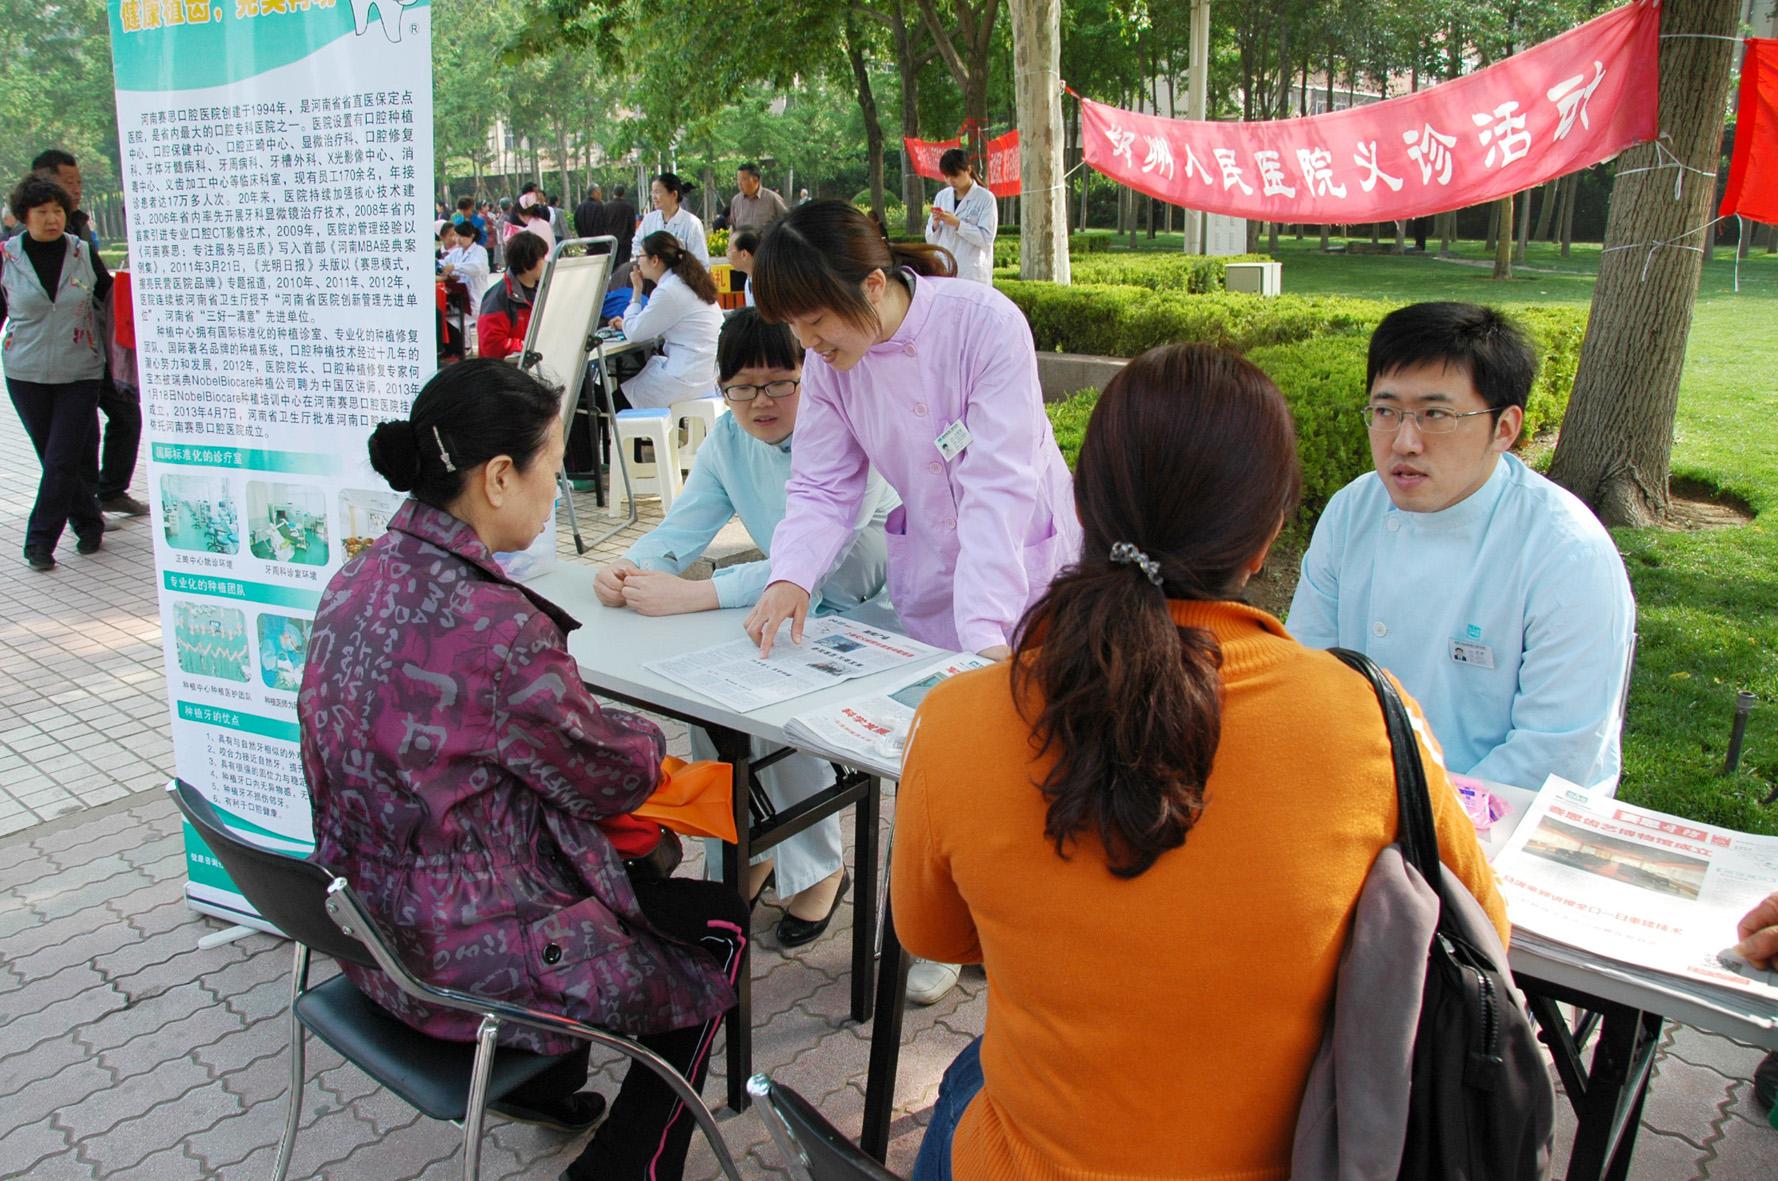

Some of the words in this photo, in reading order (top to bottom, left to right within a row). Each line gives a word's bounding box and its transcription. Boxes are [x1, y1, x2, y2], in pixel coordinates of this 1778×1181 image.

[148, 390, 411, 414] 1月18日NobelBiocare种植培训中心在河南赛思口腔医院挂
[170, 576, 246, 597] 专业化的种植团队
[184, 704, 241, 727] 种植牙的优点
